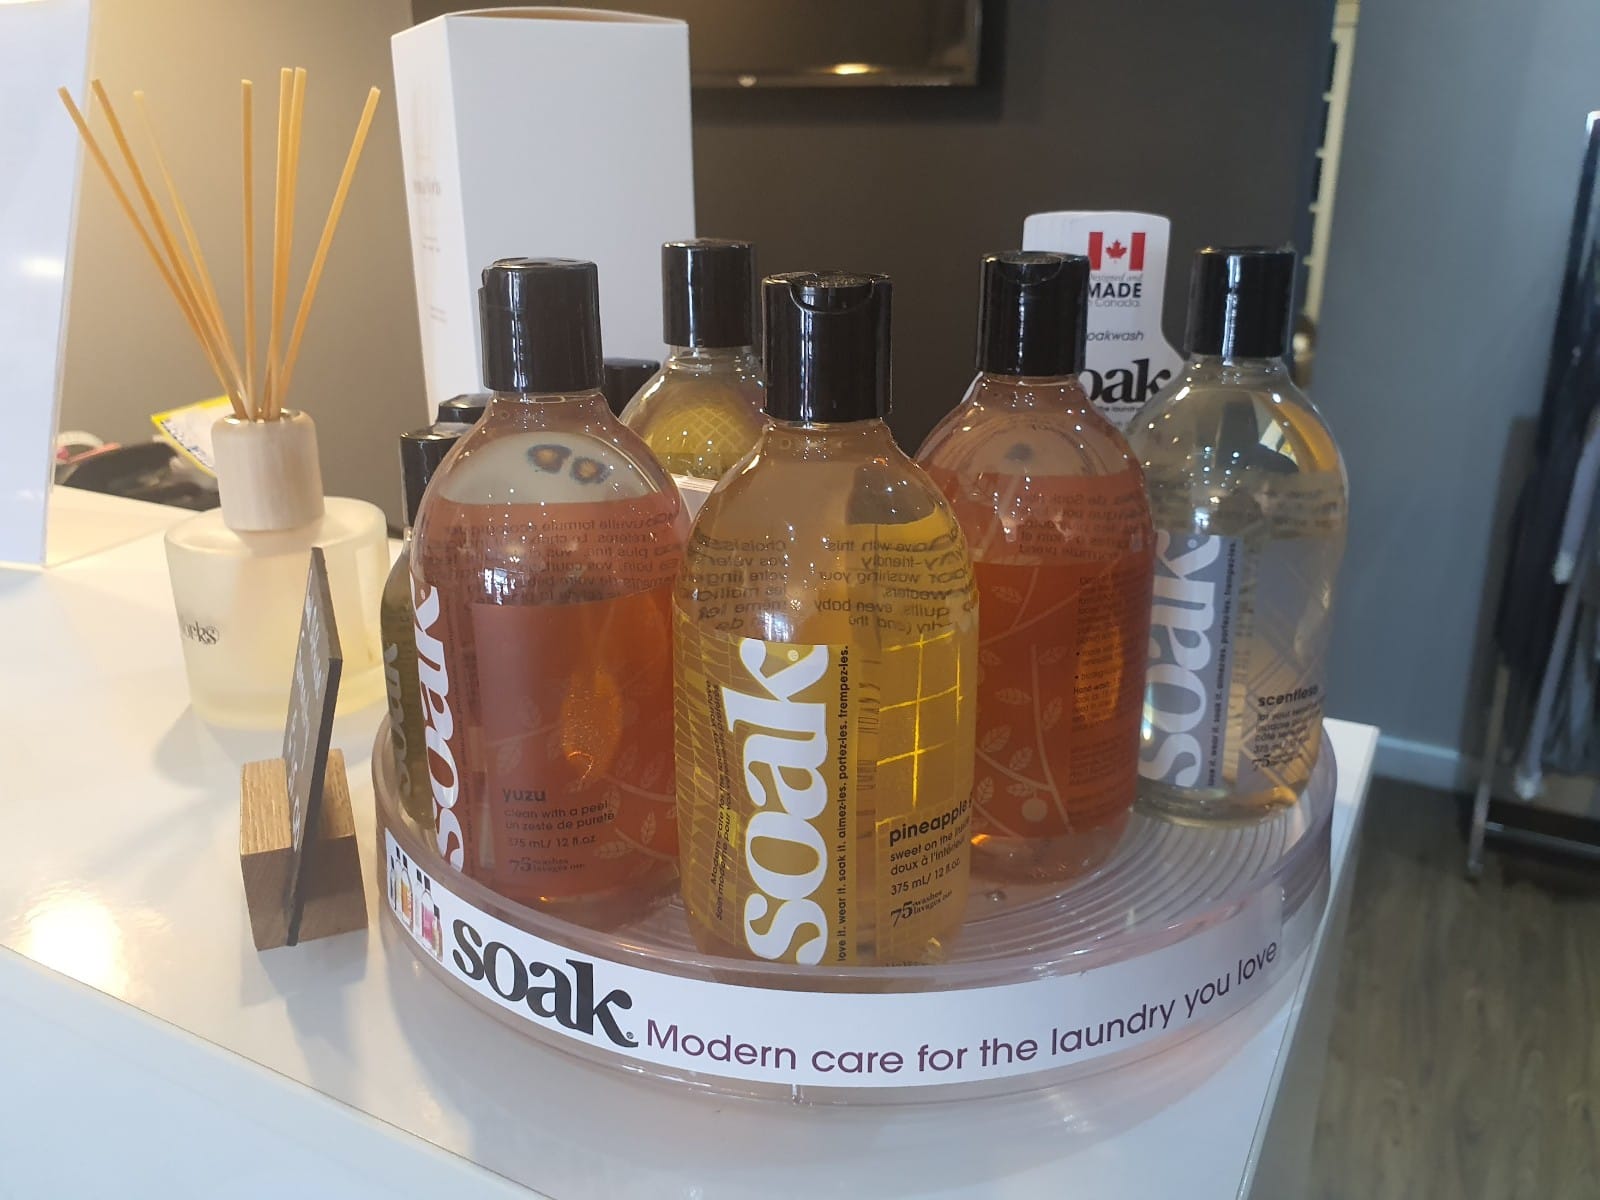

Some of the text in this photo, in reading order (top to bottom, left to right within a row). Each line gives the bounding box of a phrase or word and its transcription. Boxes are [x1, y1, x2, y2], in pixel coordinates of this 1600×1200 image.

[1087, 283, 1142, 299] MADE
[1086, 330, 1144, 341] oakwash
[1082, 358, 1171, 404] oak
[503, 789, 546, 802] yuzu
[504, 800, 608, 818] clean with a peel
[722, 637, 830, 966] soak
[837, 646, 850, 962] love it. wear it. soak it. aimez-les. portez-les. trempez-les.
[505, 822, 520, 831] un
[557, 821, 573, 830] de
[890, 799, 968, 846] pineapple
[890, 845, 922, 861] sweet
[924, 840, 937, 851] on
[940, 832, 953, 844] the
[510, 857, 532, 872] 75
[890, 860, 918, 876] doux
[921, 855, 928, 867] à
[891, 881, 909, 896] 375
[935, 867, 944, 880] 12
[890, 900, 913, 928] 75
[452, 918, 1278, 1074] soak Modern care for the laundry you love
